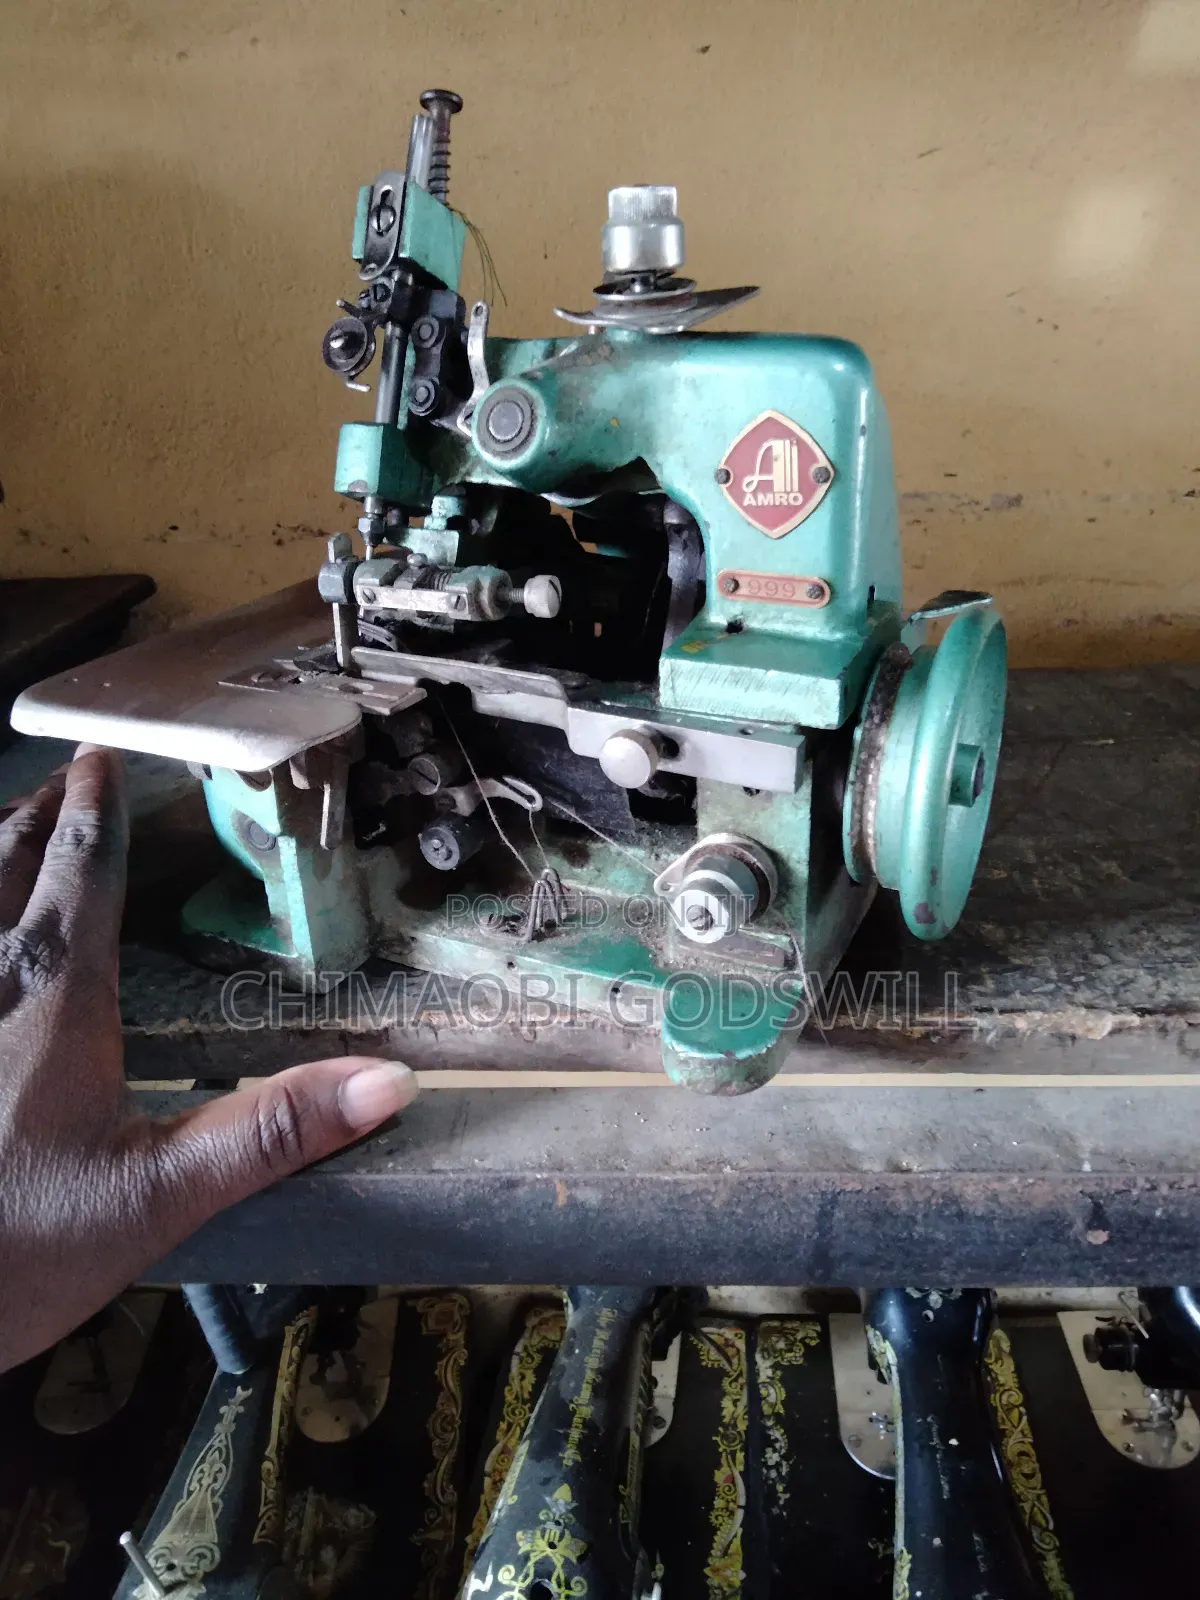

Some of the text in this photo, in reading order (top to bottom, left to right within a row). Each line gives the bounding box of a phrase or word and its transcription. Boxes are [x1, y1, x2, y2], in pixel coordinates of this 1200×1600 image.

[742, 437, 799, 493] Ali
[743, 492, 804, 507] AMRO
[748, 579, 796, 599] 999
